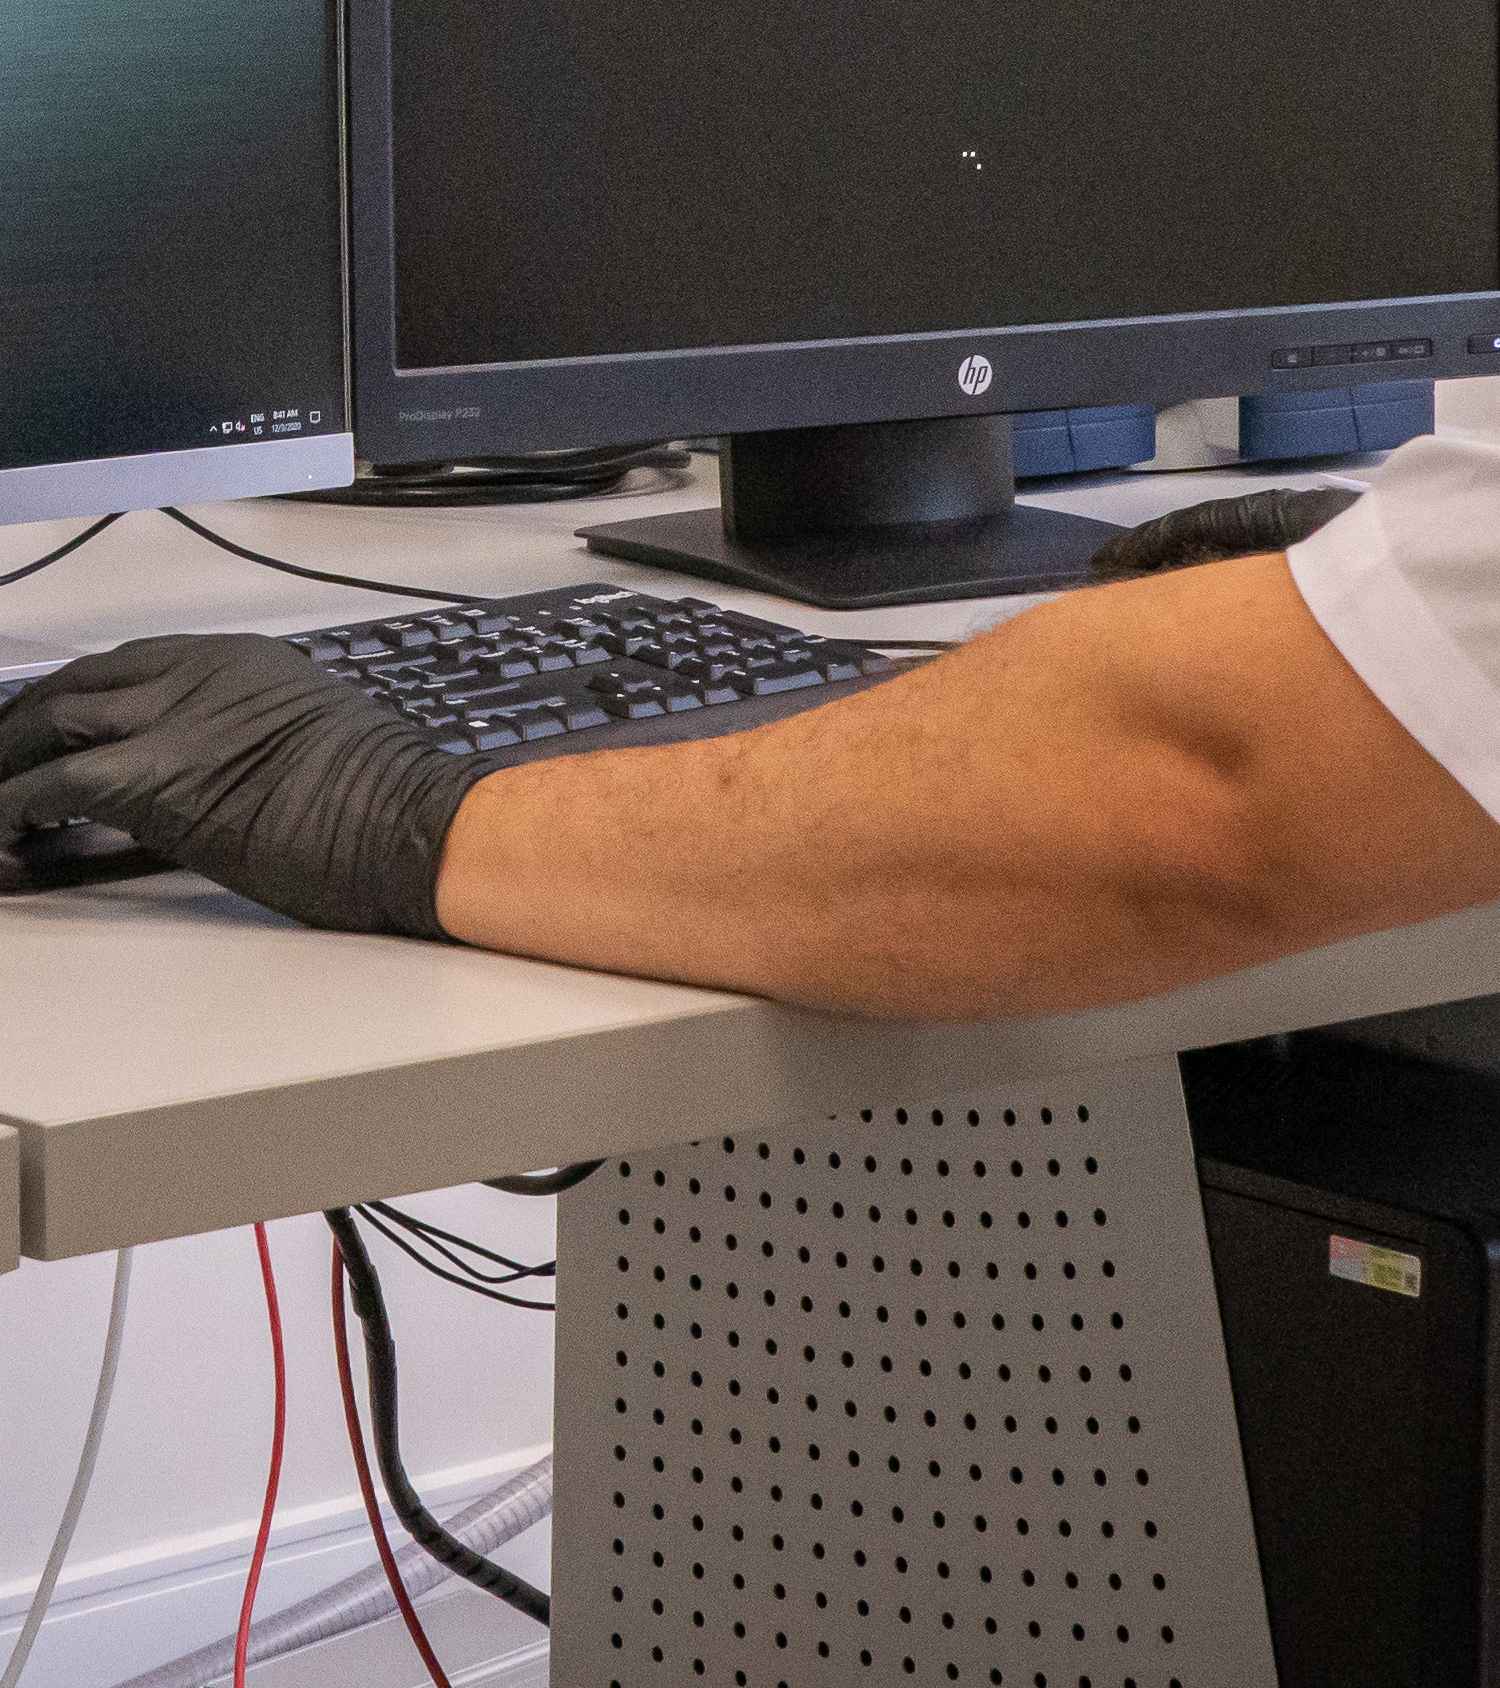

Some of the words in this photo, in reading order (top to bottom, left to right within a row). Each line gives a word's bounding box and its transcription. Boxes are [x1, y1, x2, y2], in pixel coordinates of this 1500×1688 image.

[961, 355, 990, 394] hp
[250, 413, 265, 423] ENG
[254, 426, 263, 435] US
